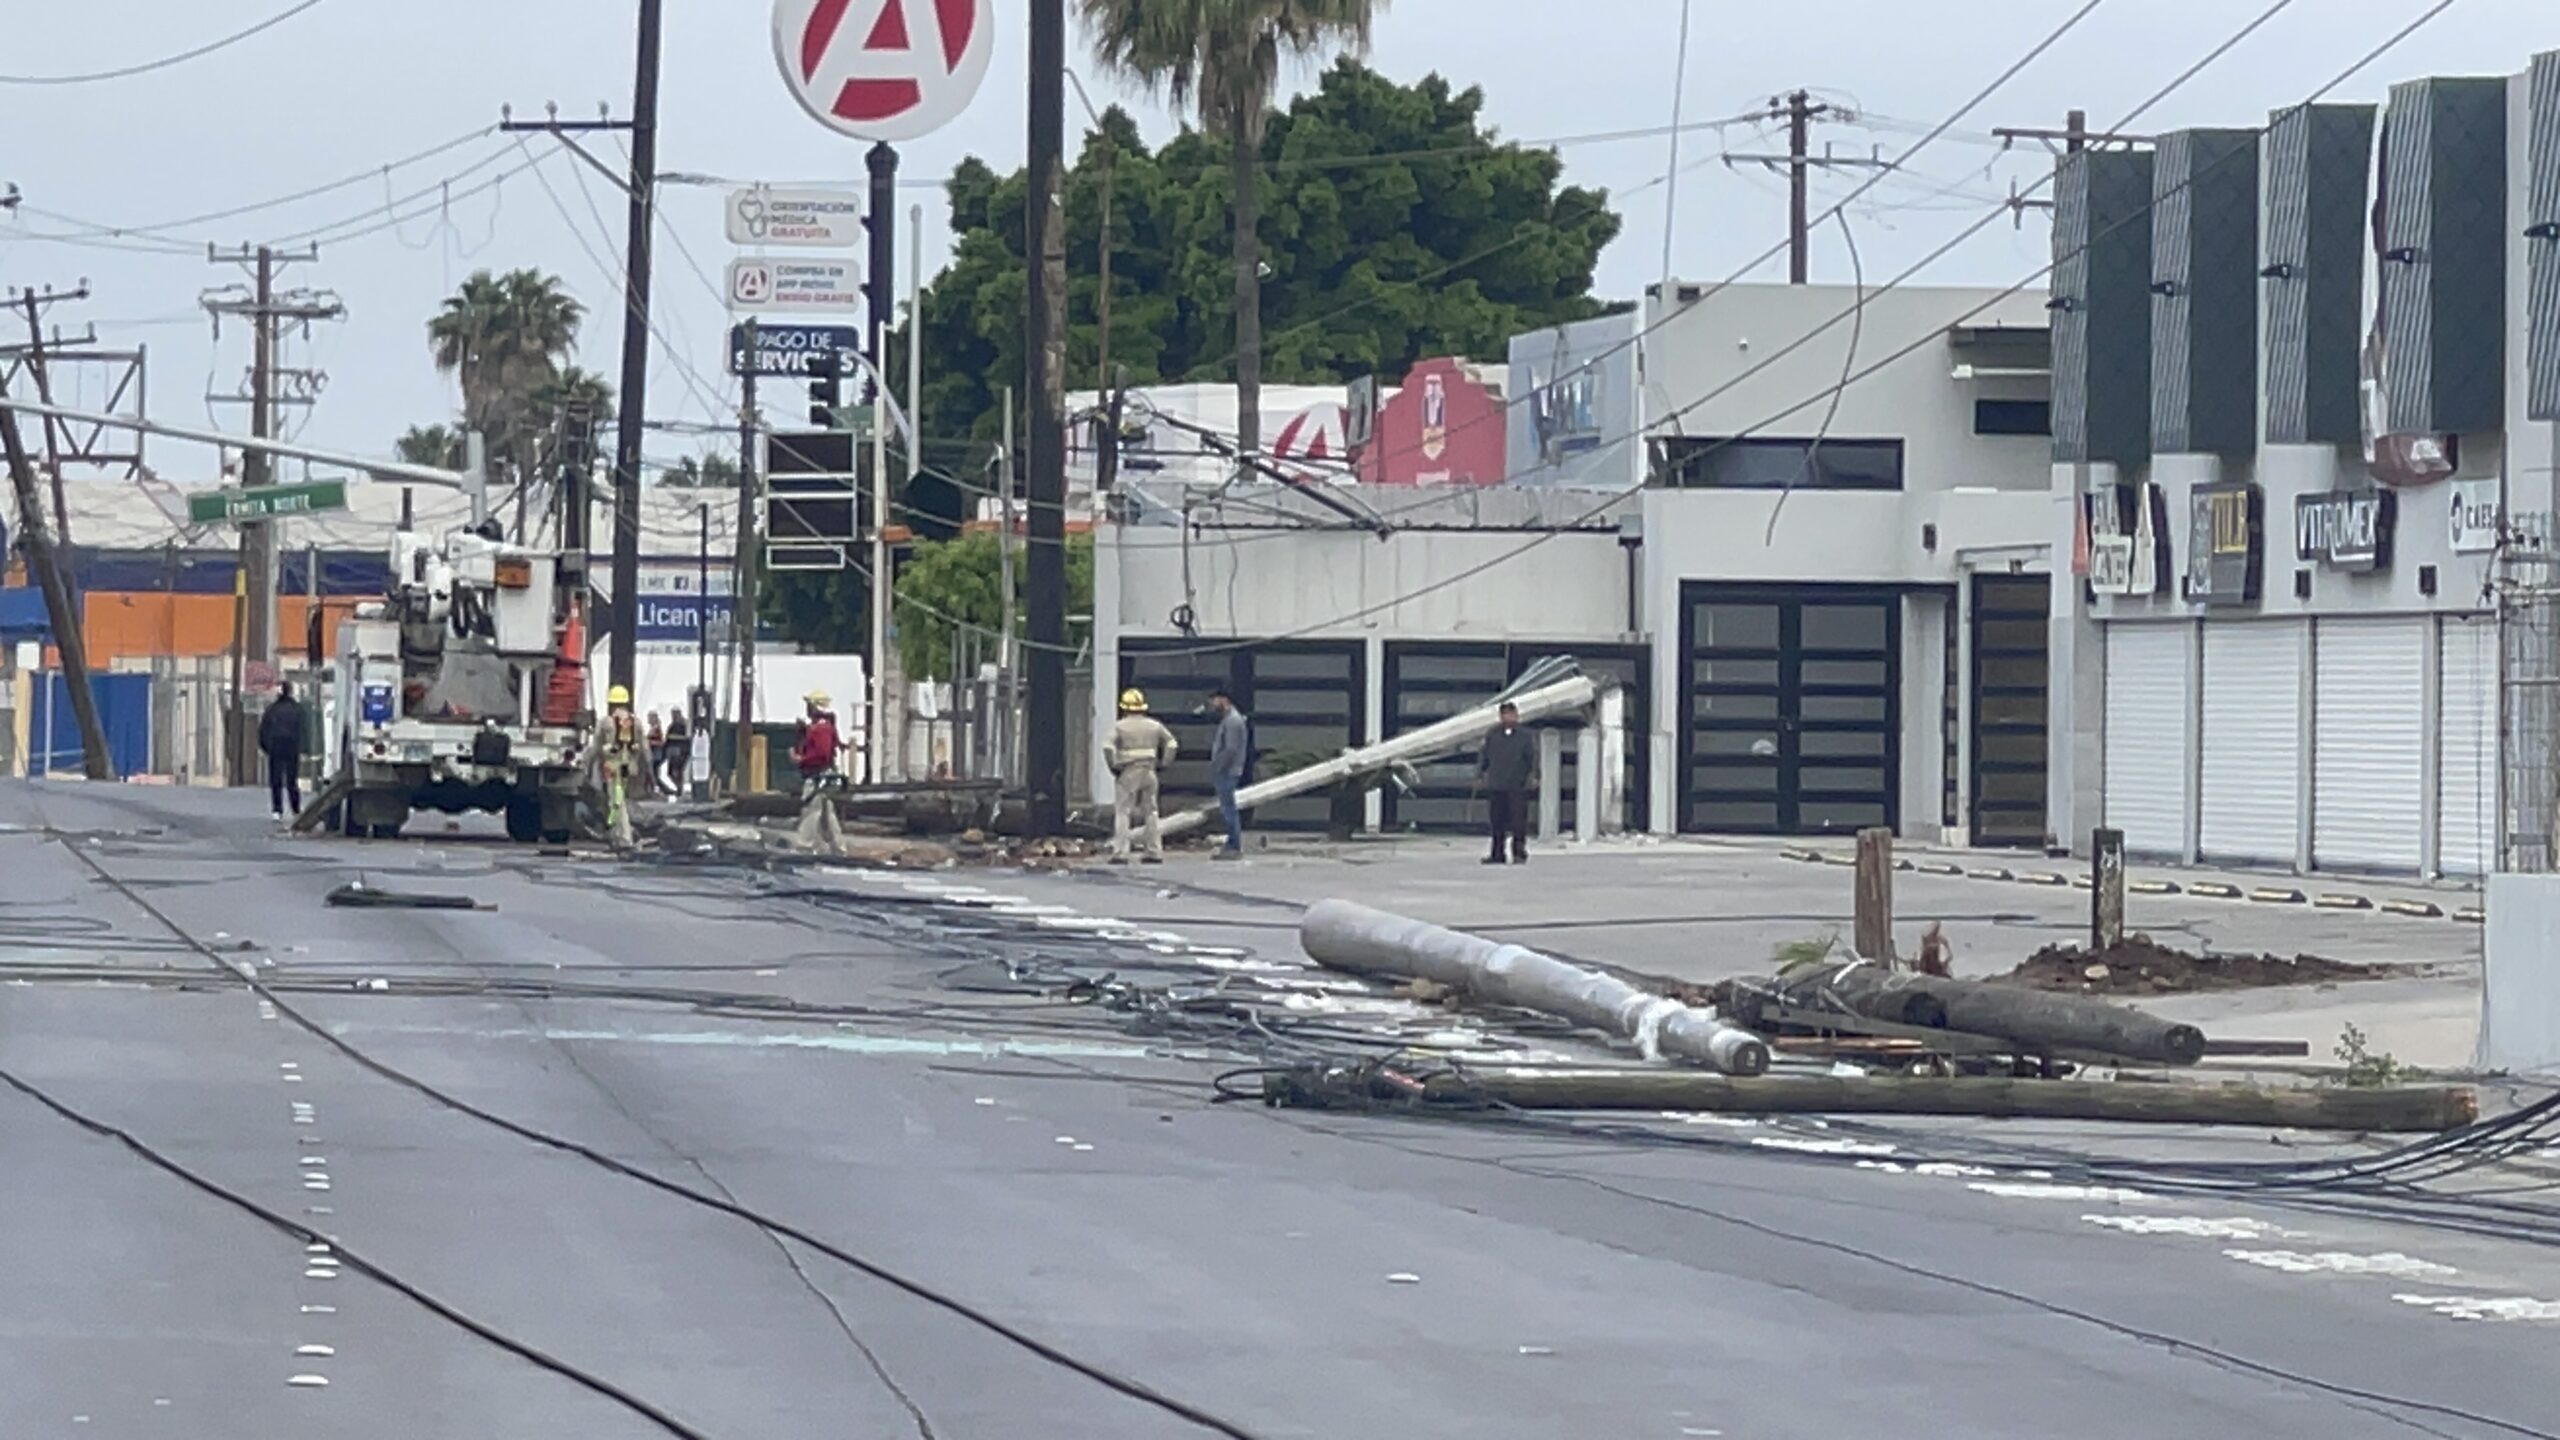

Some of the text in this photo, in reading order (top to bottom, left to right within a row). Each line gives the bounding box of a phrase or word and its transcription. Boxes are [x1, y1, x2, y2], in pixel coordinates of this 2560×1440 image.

[770, 227, 832, 239] GRATUITA
[754, 331, 833, 349] PAGO DE
[2298, 498, 2380, 552] VITROMEX
